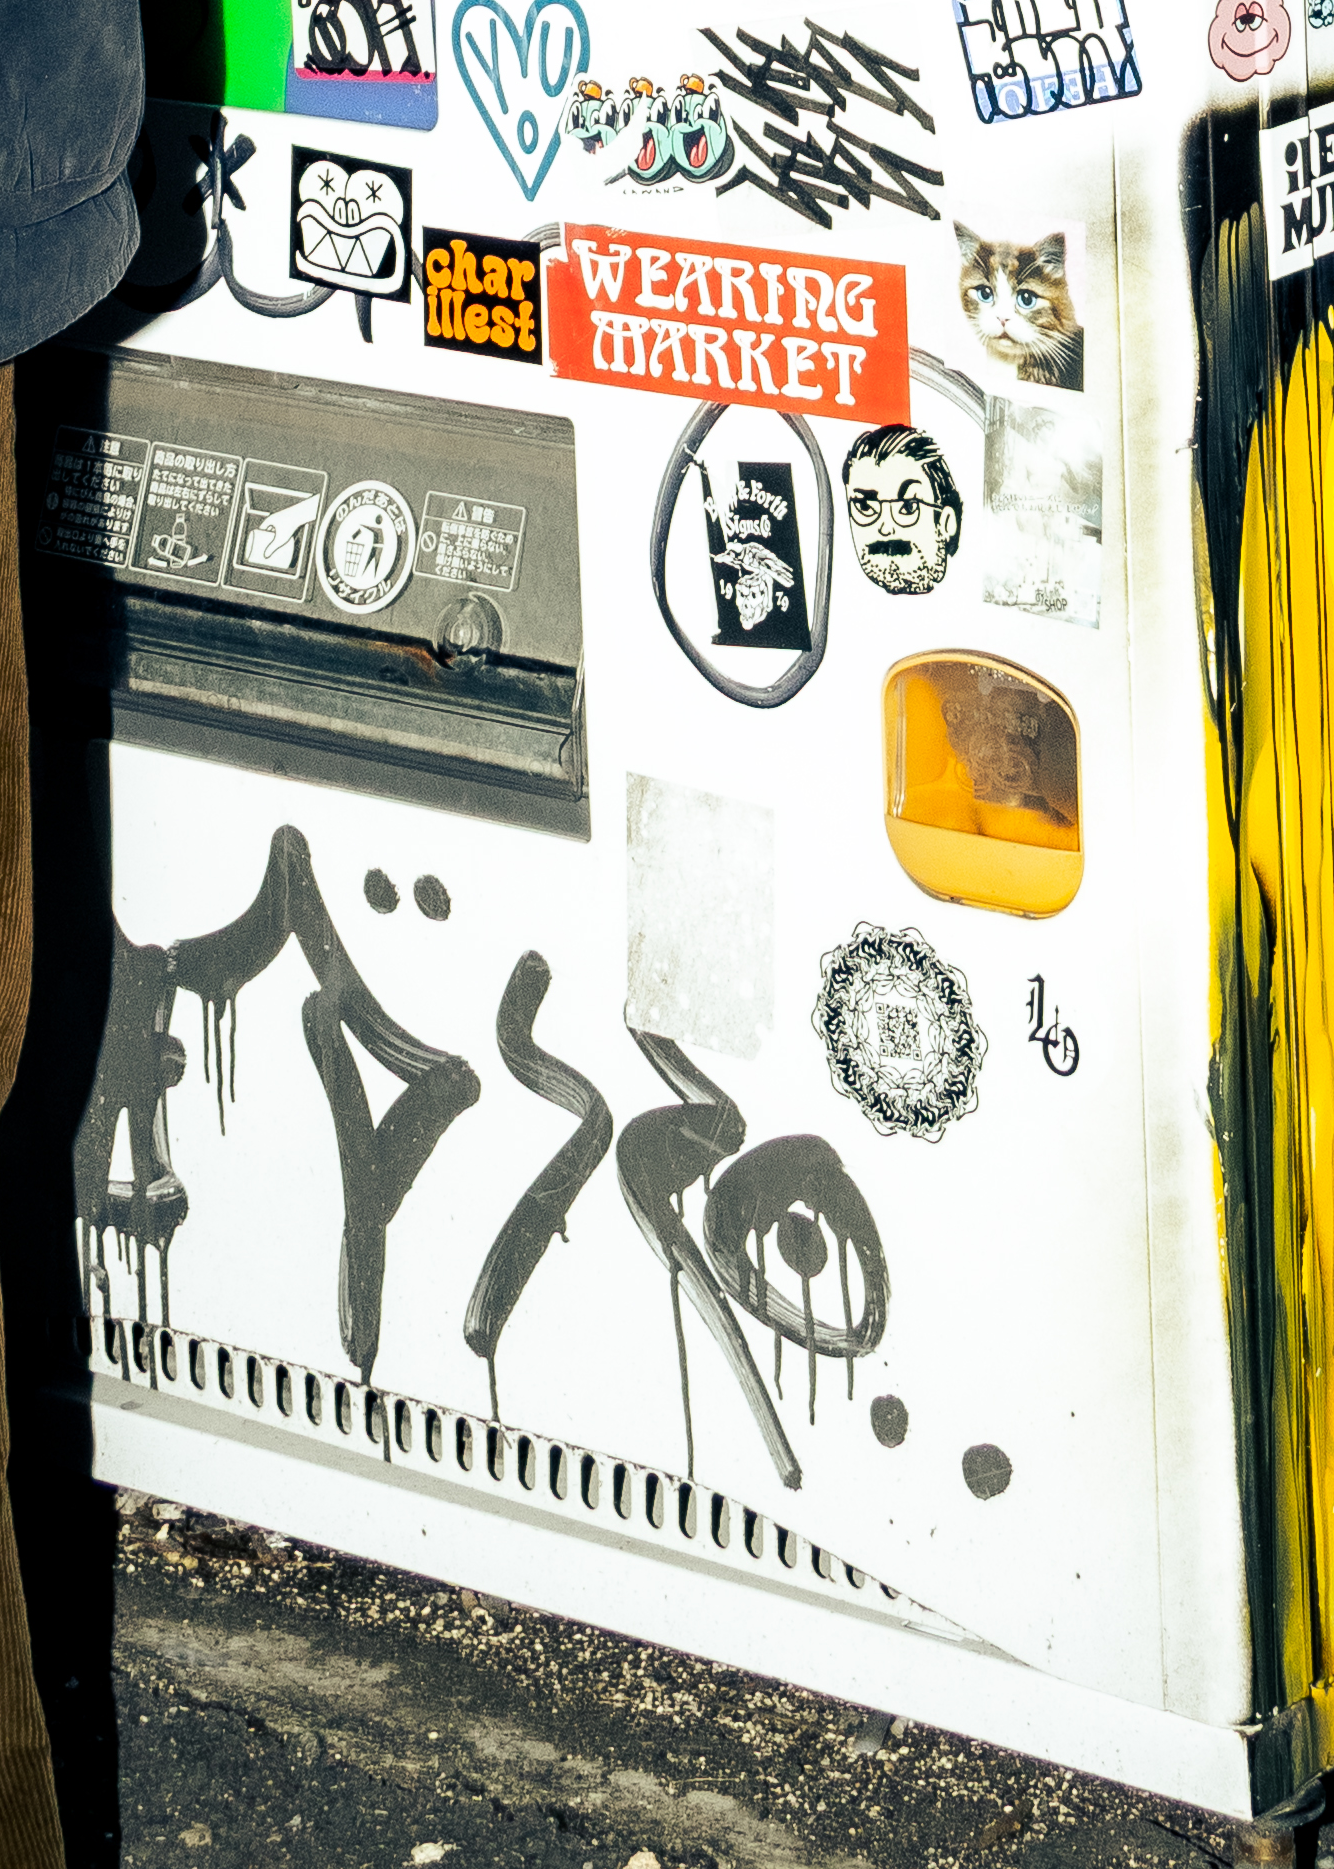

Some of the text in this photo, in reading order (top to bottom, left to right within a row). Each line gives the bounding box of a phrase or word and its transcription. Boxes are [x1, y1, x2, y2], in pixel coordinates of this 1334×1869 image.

[427, 239, 537, 302] char
[572, 237, 878, 338] WEARING
[428, 290, 536, 352] illest
[591, 309, 866, 406] MARKET
[727, 512, 759, 539] Signs
[750, 480, 788, 521] Forth
[327, 568, 391, 604] リサイクル
[719, 578, 733, 600] 19
